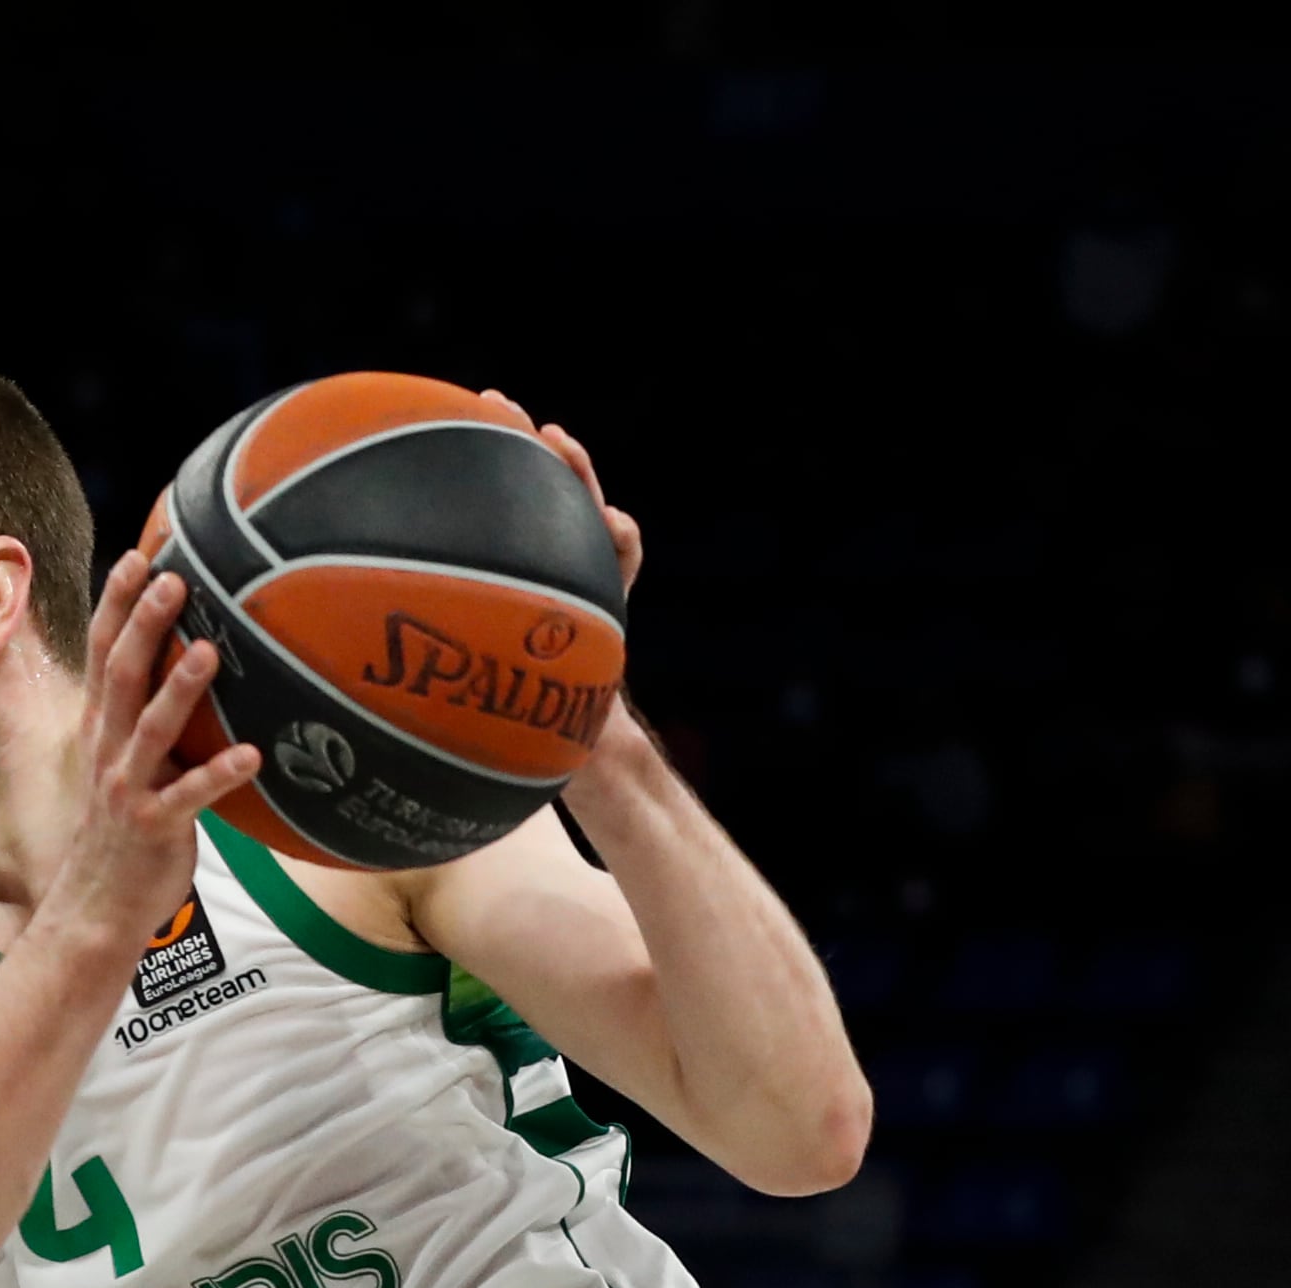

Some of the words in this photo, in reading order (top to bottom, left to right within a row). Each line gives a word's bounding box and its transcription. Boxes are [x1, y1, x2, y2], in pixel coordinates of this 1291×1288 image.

[362, 610, 617, 750] SPALDIN
[137, 932, 208, 975] TURKISH
[141, 947, 213, 990] AIRLINES
[143, 961, 217, 1002] EuroLeague
[19, 1154, 145, 1279] 4
